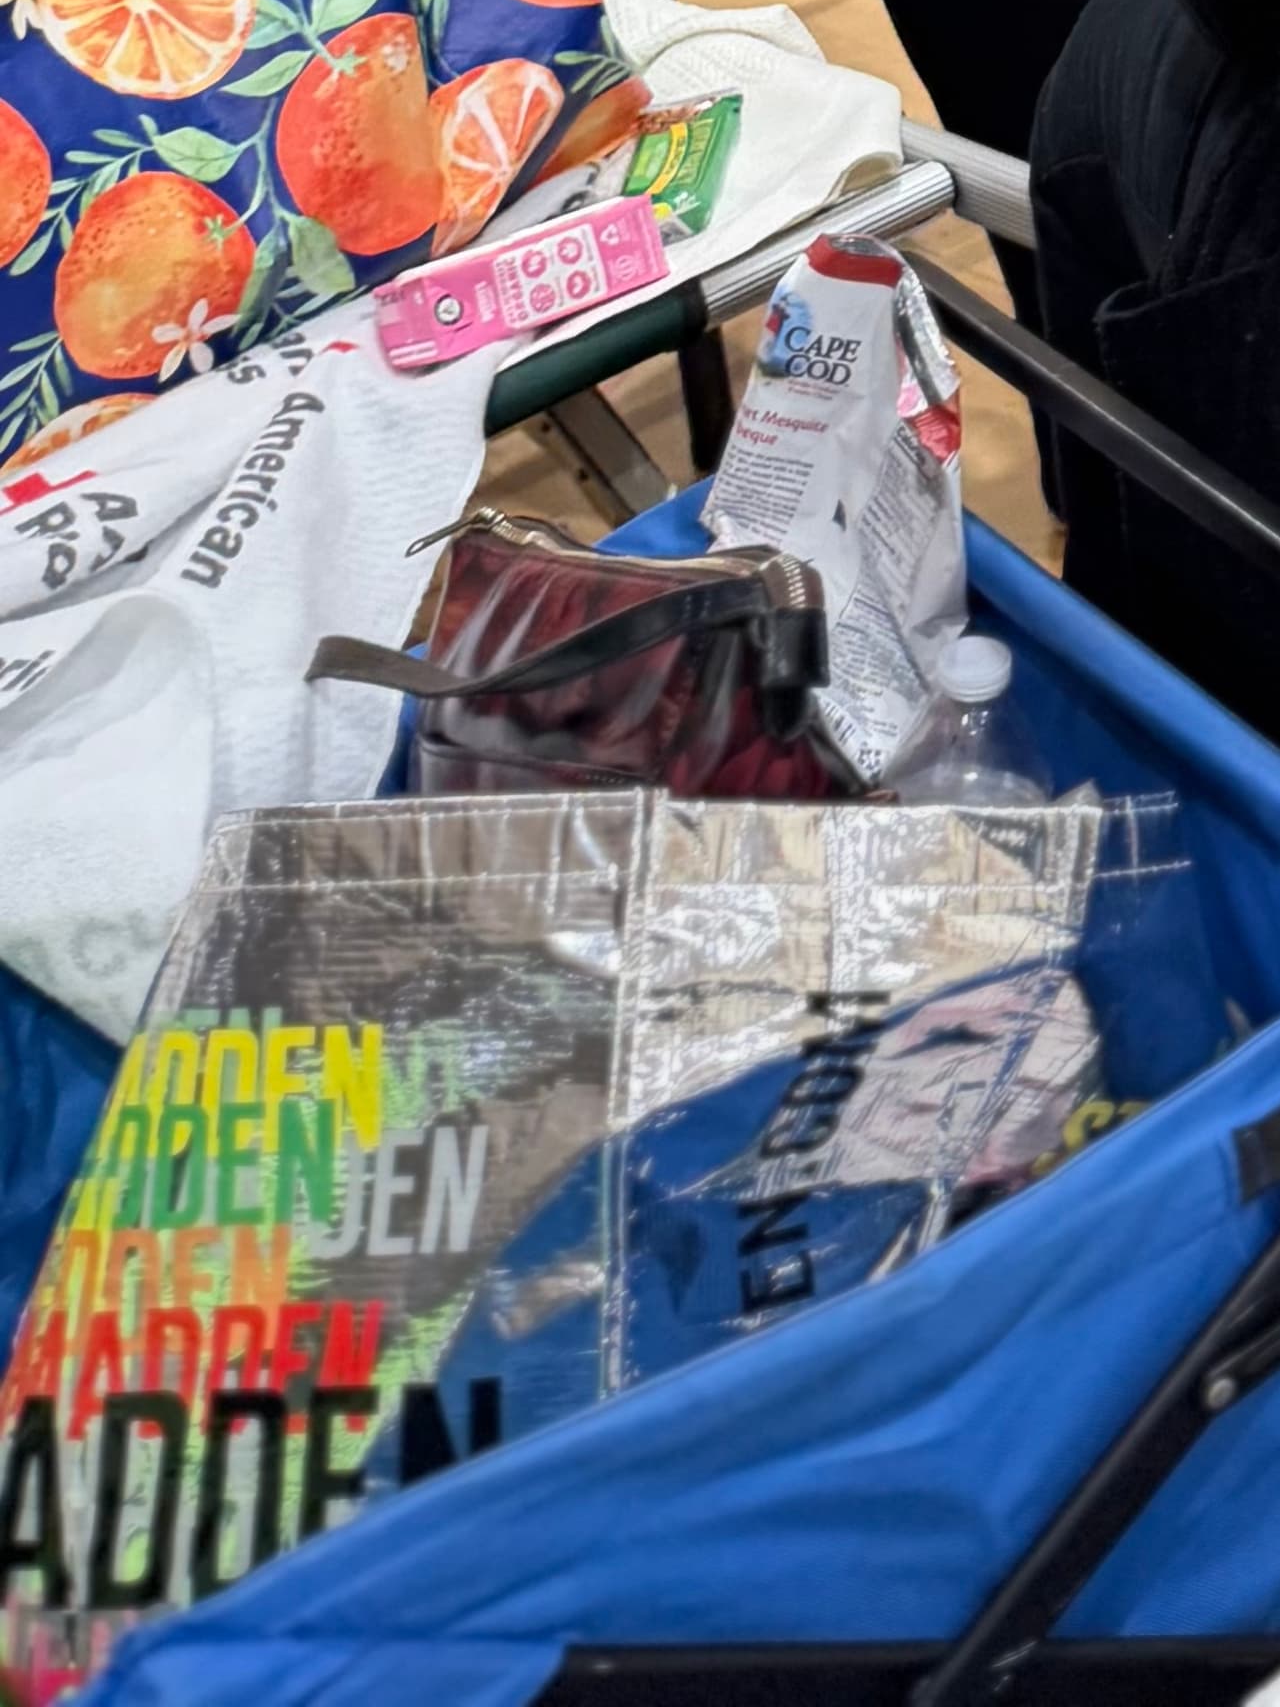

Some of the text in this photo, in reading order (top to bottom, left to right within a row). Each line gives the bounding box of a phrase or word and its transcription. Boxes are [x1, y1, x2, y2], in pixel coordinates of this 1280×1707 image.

[783, 326, 862, 363] CAPE
[784, 354, 853, 386] COD
[181, 390, 325, 589] American
